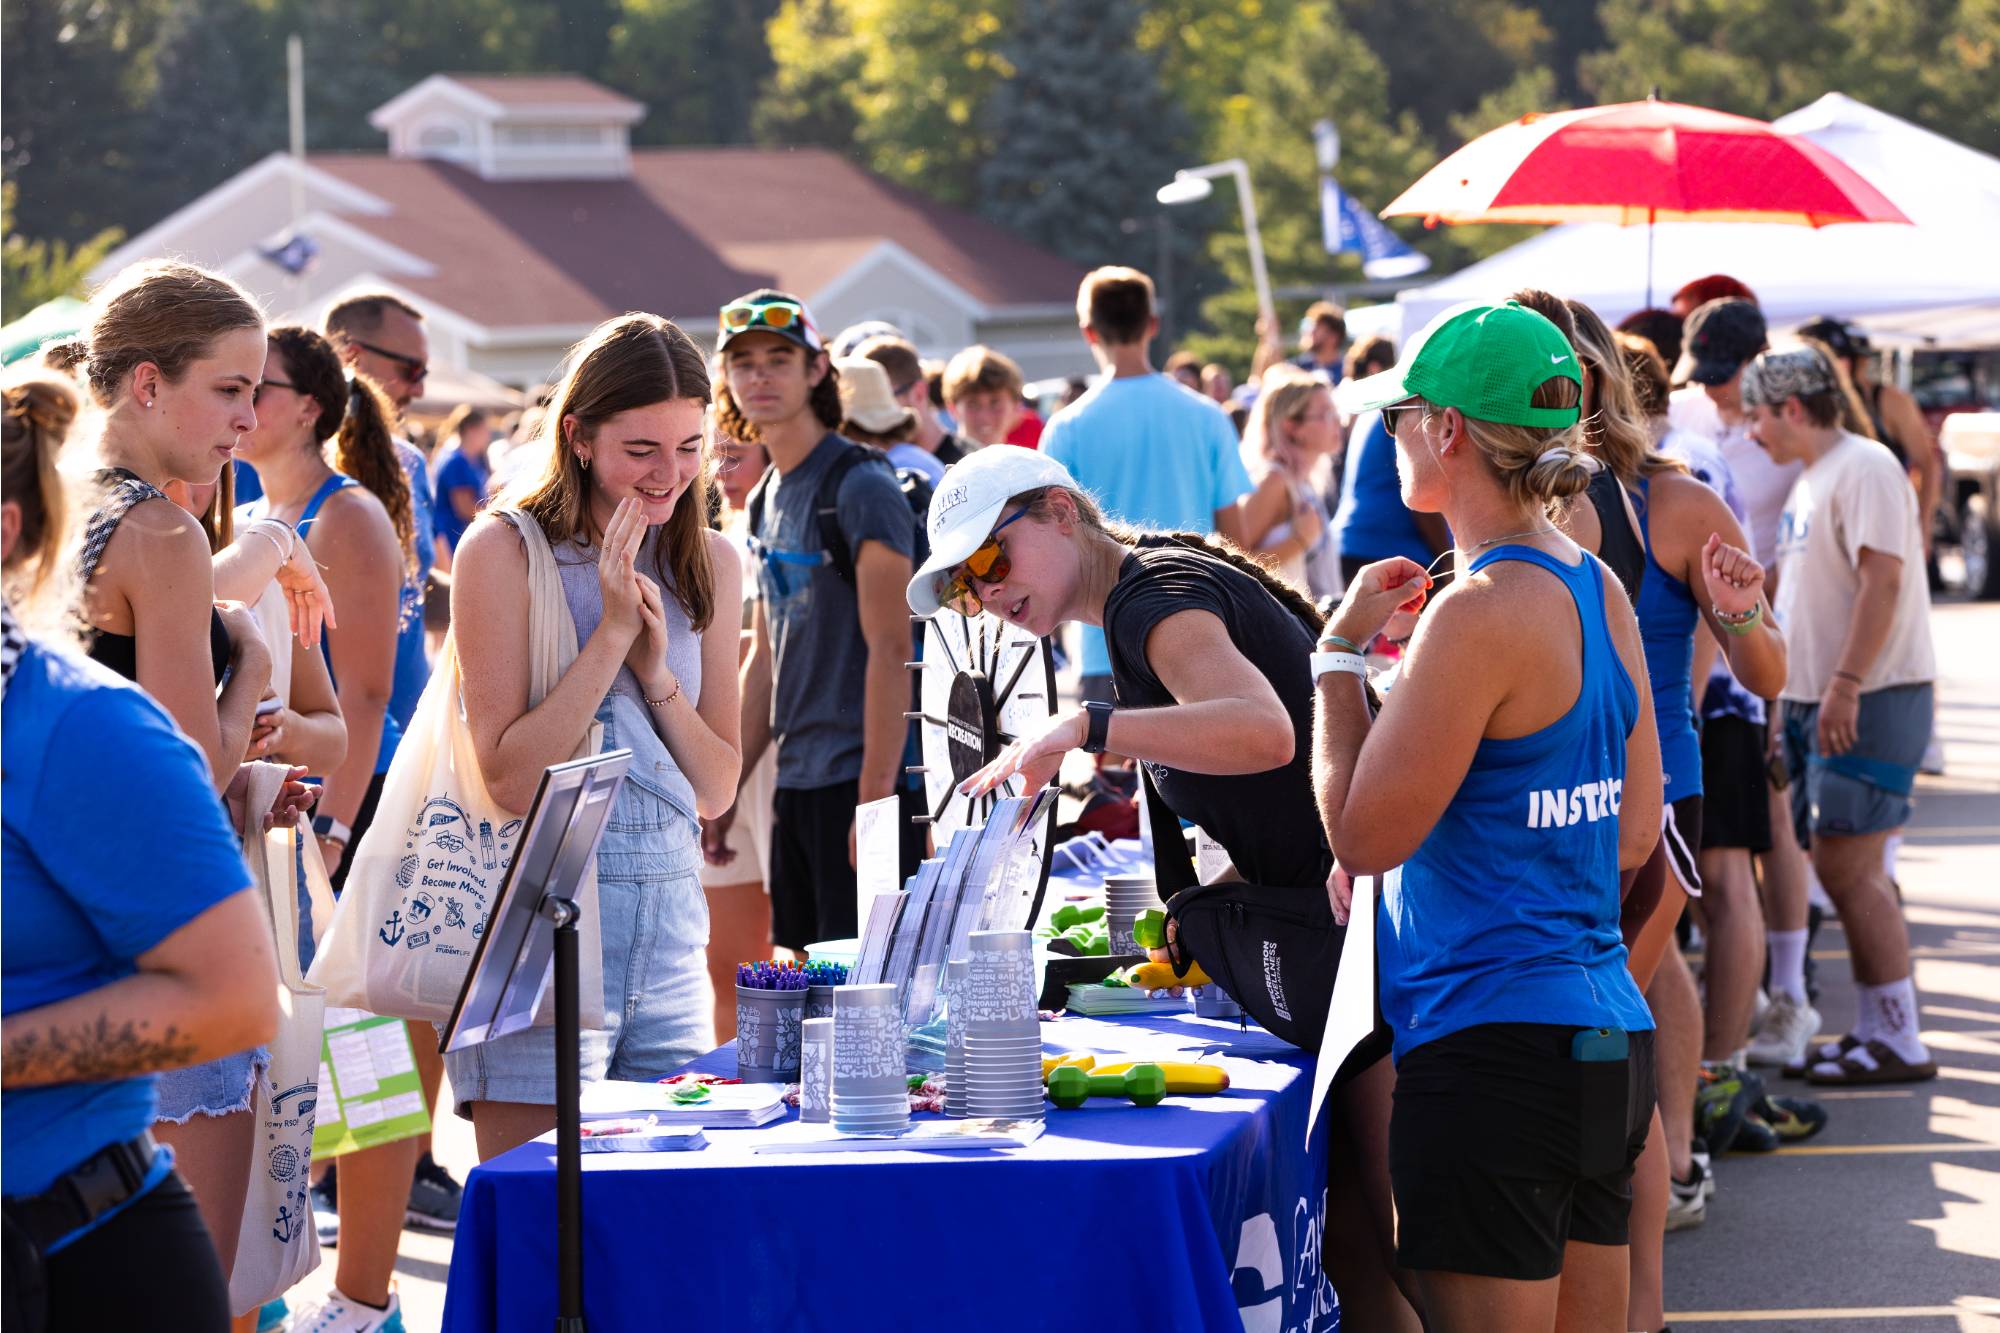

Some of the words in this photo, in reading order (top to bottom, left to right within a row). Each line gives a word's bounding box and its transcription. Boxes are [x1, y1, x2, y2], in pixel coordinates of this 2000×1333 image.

[948, 722, 982, 753] RECREATION
[427, 858, 444, 871] Get
[446, 860, 487, 889] Involved.
[421, 875, 457, 889] Become
[458, 881, 487, 903] More.
[1263, 940, 1279, 1007] RECREATION
[1269, 942, 1281, 1000] WELLNESS
[997, 986, 1010, 994] be
[1001, 999, 1018, 1008] get
[858, 1043, 872, 1051] be
[862, 1056, 880, 1065] get
